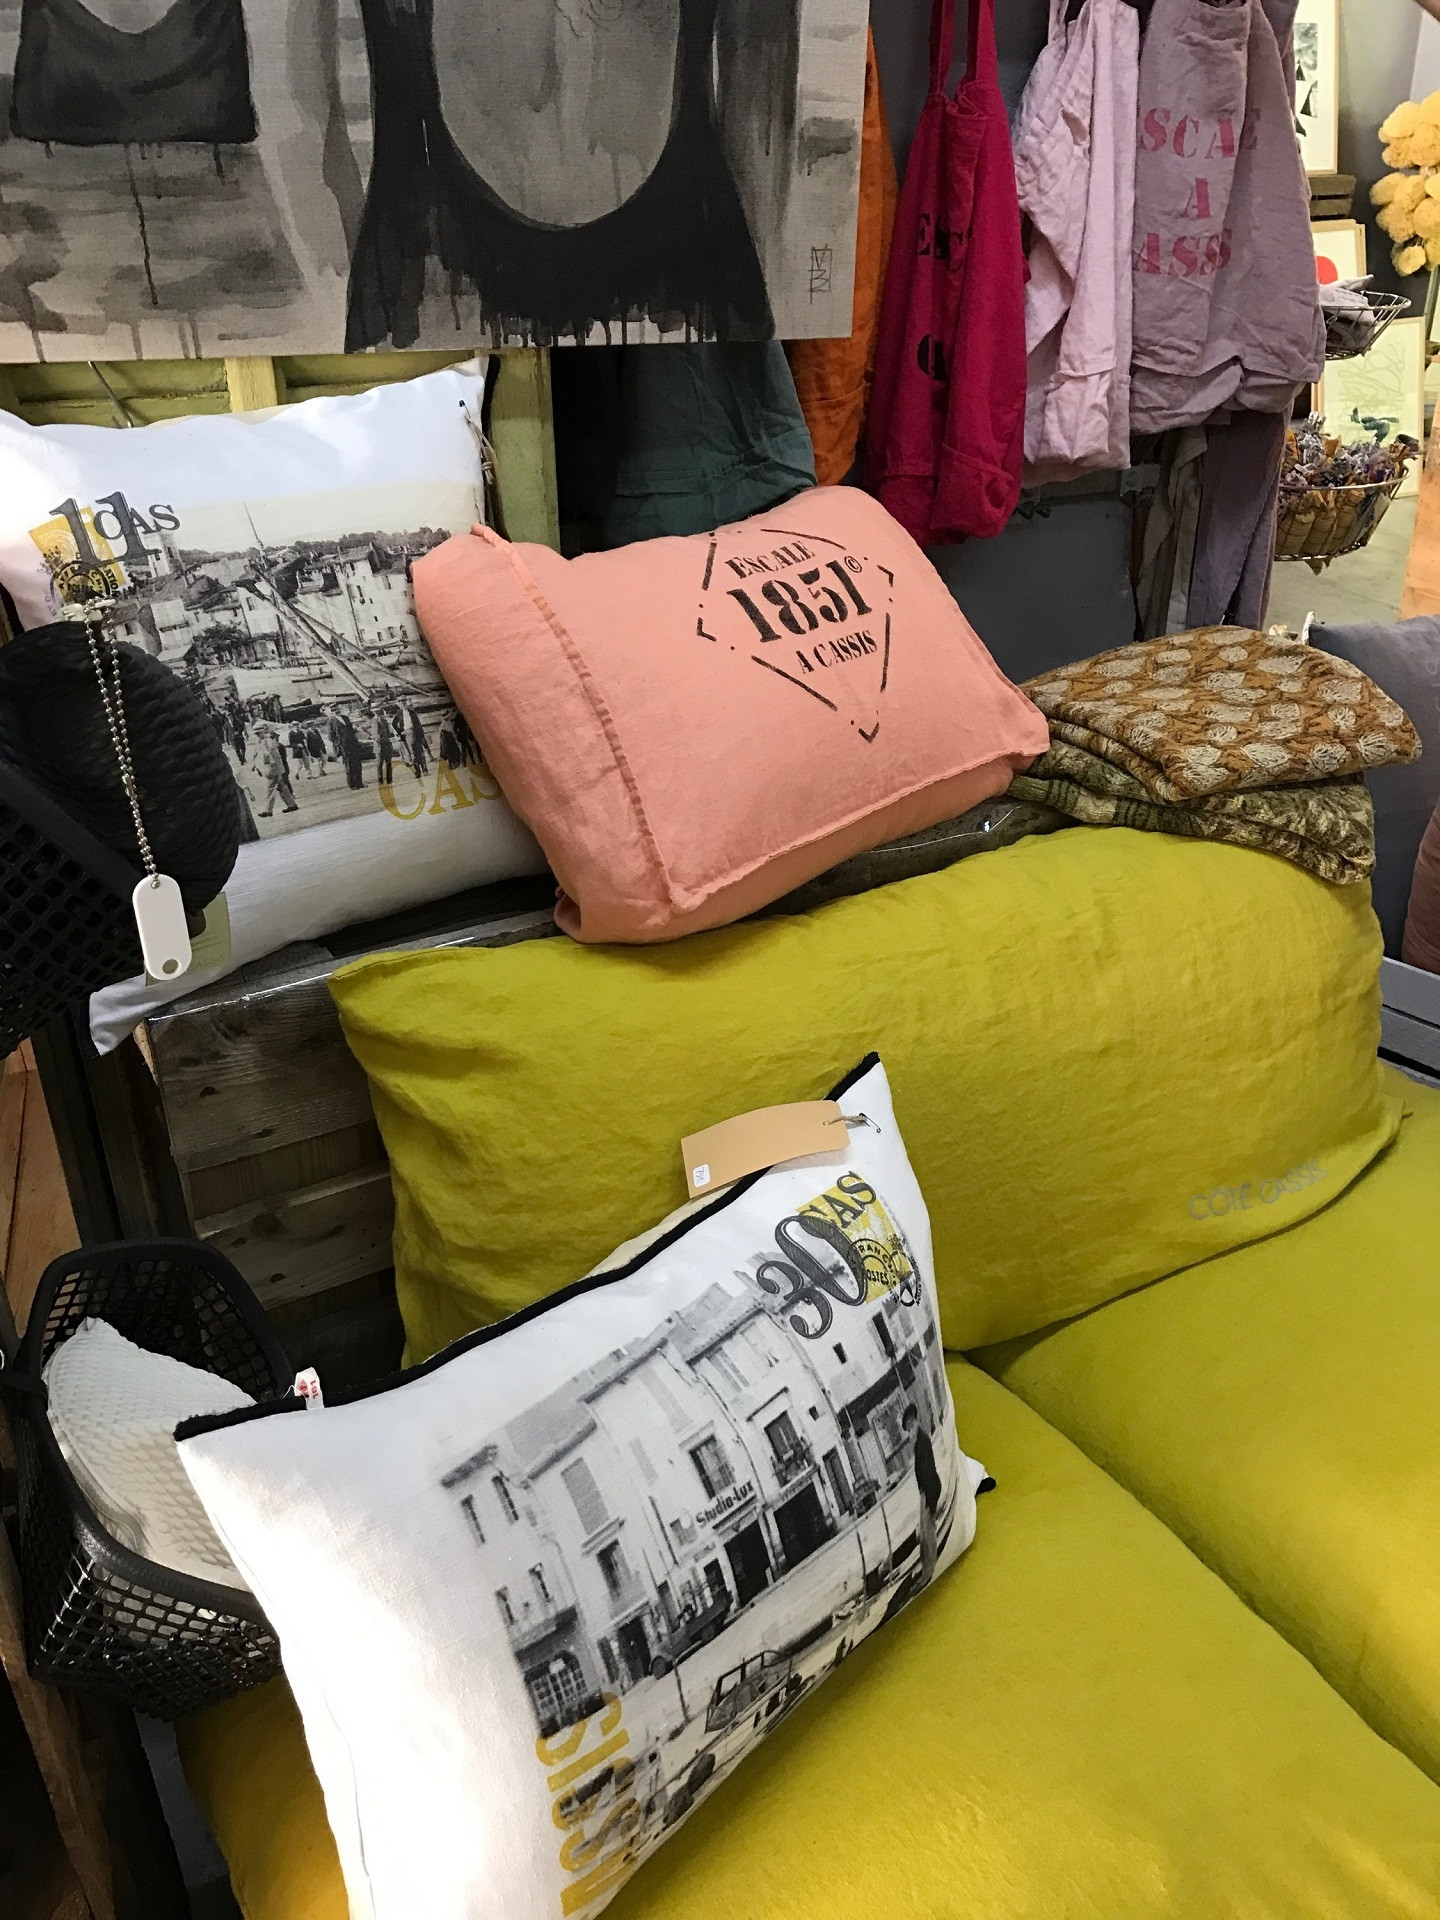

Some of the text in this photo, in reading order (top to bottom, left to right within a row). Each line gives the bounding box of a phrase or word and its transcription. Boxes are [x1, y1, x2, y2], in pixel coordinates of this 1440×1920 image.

[1177, 176, 1213, 219] A
[725, 540, 816, 579] ESCALE
[796, 629, 878, 674] A CASSIS
[756, 1214, 868, 1340] 30
